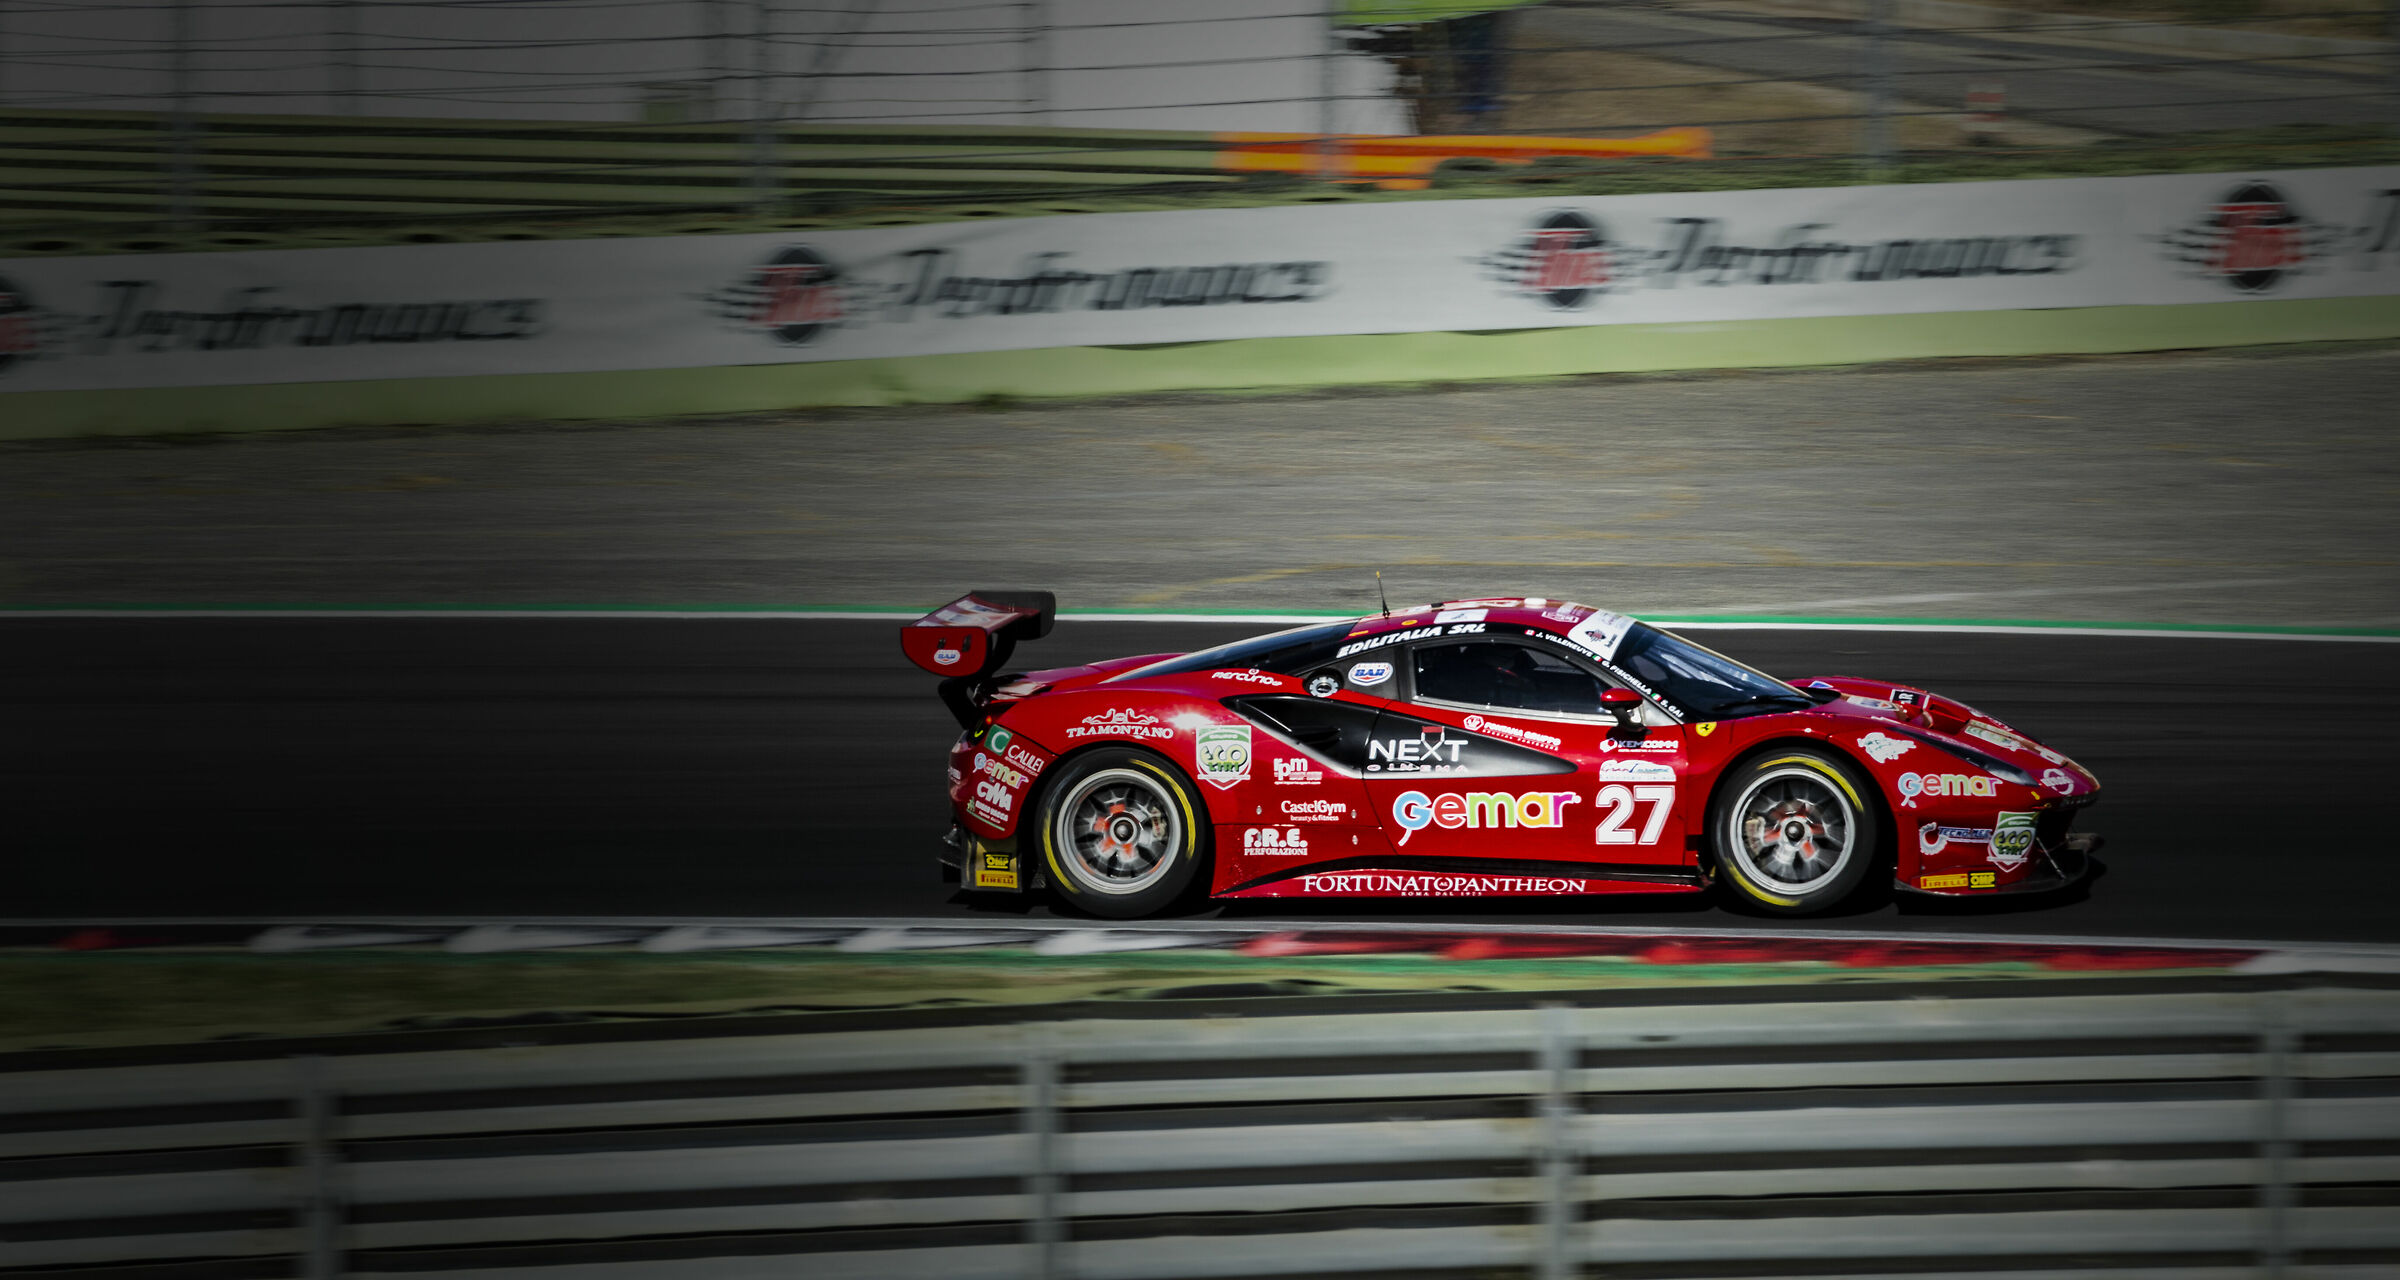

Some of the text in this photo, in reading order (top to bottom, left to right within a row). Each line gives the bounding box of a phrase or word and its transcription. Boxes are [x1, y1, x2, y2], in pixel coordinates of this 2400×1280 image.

[1336, 623, 1486, 658] EDILITALIA SRL
[1545, 634, 1592, 658] VILLENEUVE
[1610, 665, 1652, 695] FISICHELLA
[1668, 705, 1685, 718] GAI
[1066, 725, 1174, 739] TRAMONTANO
[1369, 737, 1468, 762] NEXT
[972, 752, 1029, 789] Gemar
[1274, 758, 1307, 780] rpm
[1898, 772, 2003, 808] Gemar
[1281, 800, 1346, 815] CastelGym
[1393, 791, 1582, 846] Gemar
[1596, 784, 1676, 845] 27
[1244, 828, 1308, 848] F.R.E.
[981, 874, 1014, 884] PIRELLI
[1922, 876, 1967, 888] PIRELLI
